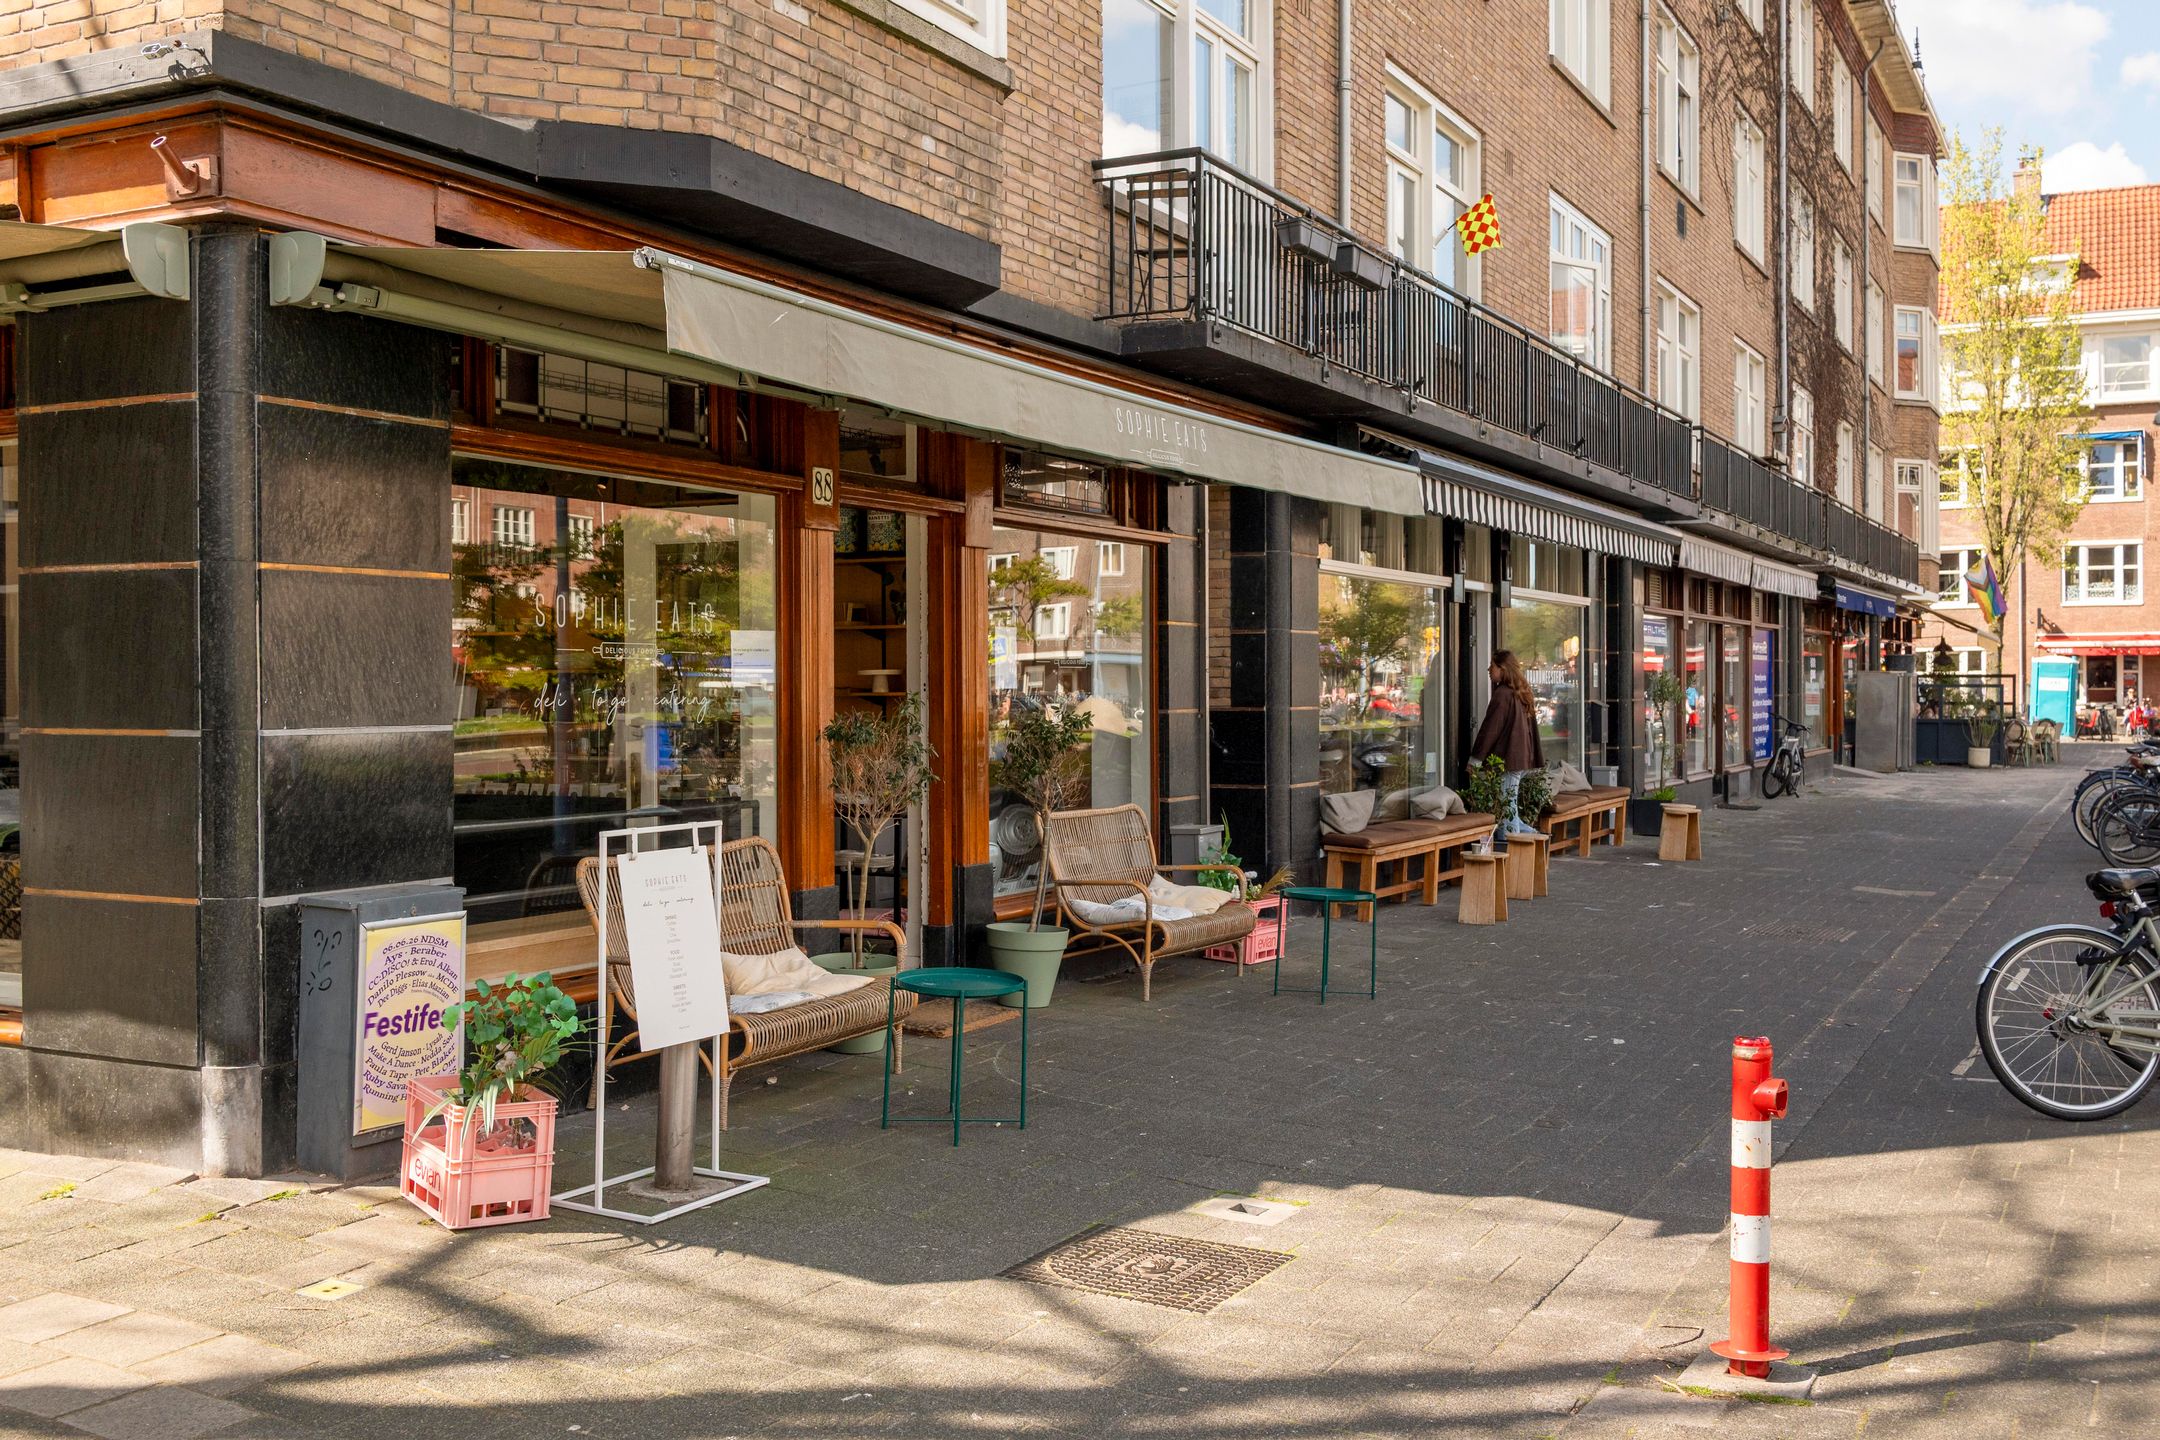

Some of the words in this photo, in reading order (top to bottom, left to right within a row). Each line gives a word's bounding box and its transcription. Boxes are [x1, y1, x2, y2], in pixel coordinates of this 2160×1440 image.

[1116, 407, 1169, 443] SOPHIE
[1175, 421, 1207, 453] EATS
[814, 471, 832, 502] 88
[535, 593, 637, 631] SOPHIE
[655, 600, 714, 634] EATS
[534, 683, 567, 712] deli
[654, 684, 711, 724] catering
[382, 936, 418, 955] 06.06.26
[420, 935, 449, 948] NDSM
[384, 951, 402, 966] Ays
[410, 946, 447, 958] Beraber
[1257, 935, 1277, 950] evian
[367, 978, 394, 1006] Danilo
[395, 969, 428, 982] Plessow
[435, 972, 459, 994] MCDE
[368, 959, 410, 990] CC:DISCO!
[420, 957, 437, 967] Erol
[437, 961, 459, 980] Alkan
[377, 993, 389, 1008] Dee
[389, 982, 408, 998] Diggs
[411, 978, 428, 988] Elias
[365, 1057, 388, 1076] Paula
[389, 1069, 409, 1081] Tape
[414, 1066, 430, 1077] Pete
[431, 1042, 455, 1069] Blaker
[368, 1045, 387, 1063] Make
[386, 1058, 393, 1066] A
[394, 1059, 416, 1069] Dance
[420, 1046, 442, 1064] Nedda
[381, 1041, 399, 1055] Gerd
[396, 1047, 421, 1059] Janson
[362, 1083, 400, 1103] Running
[363, 1070, 386, 1088] Ruby
[414, 1157, 442, 1192] evian
